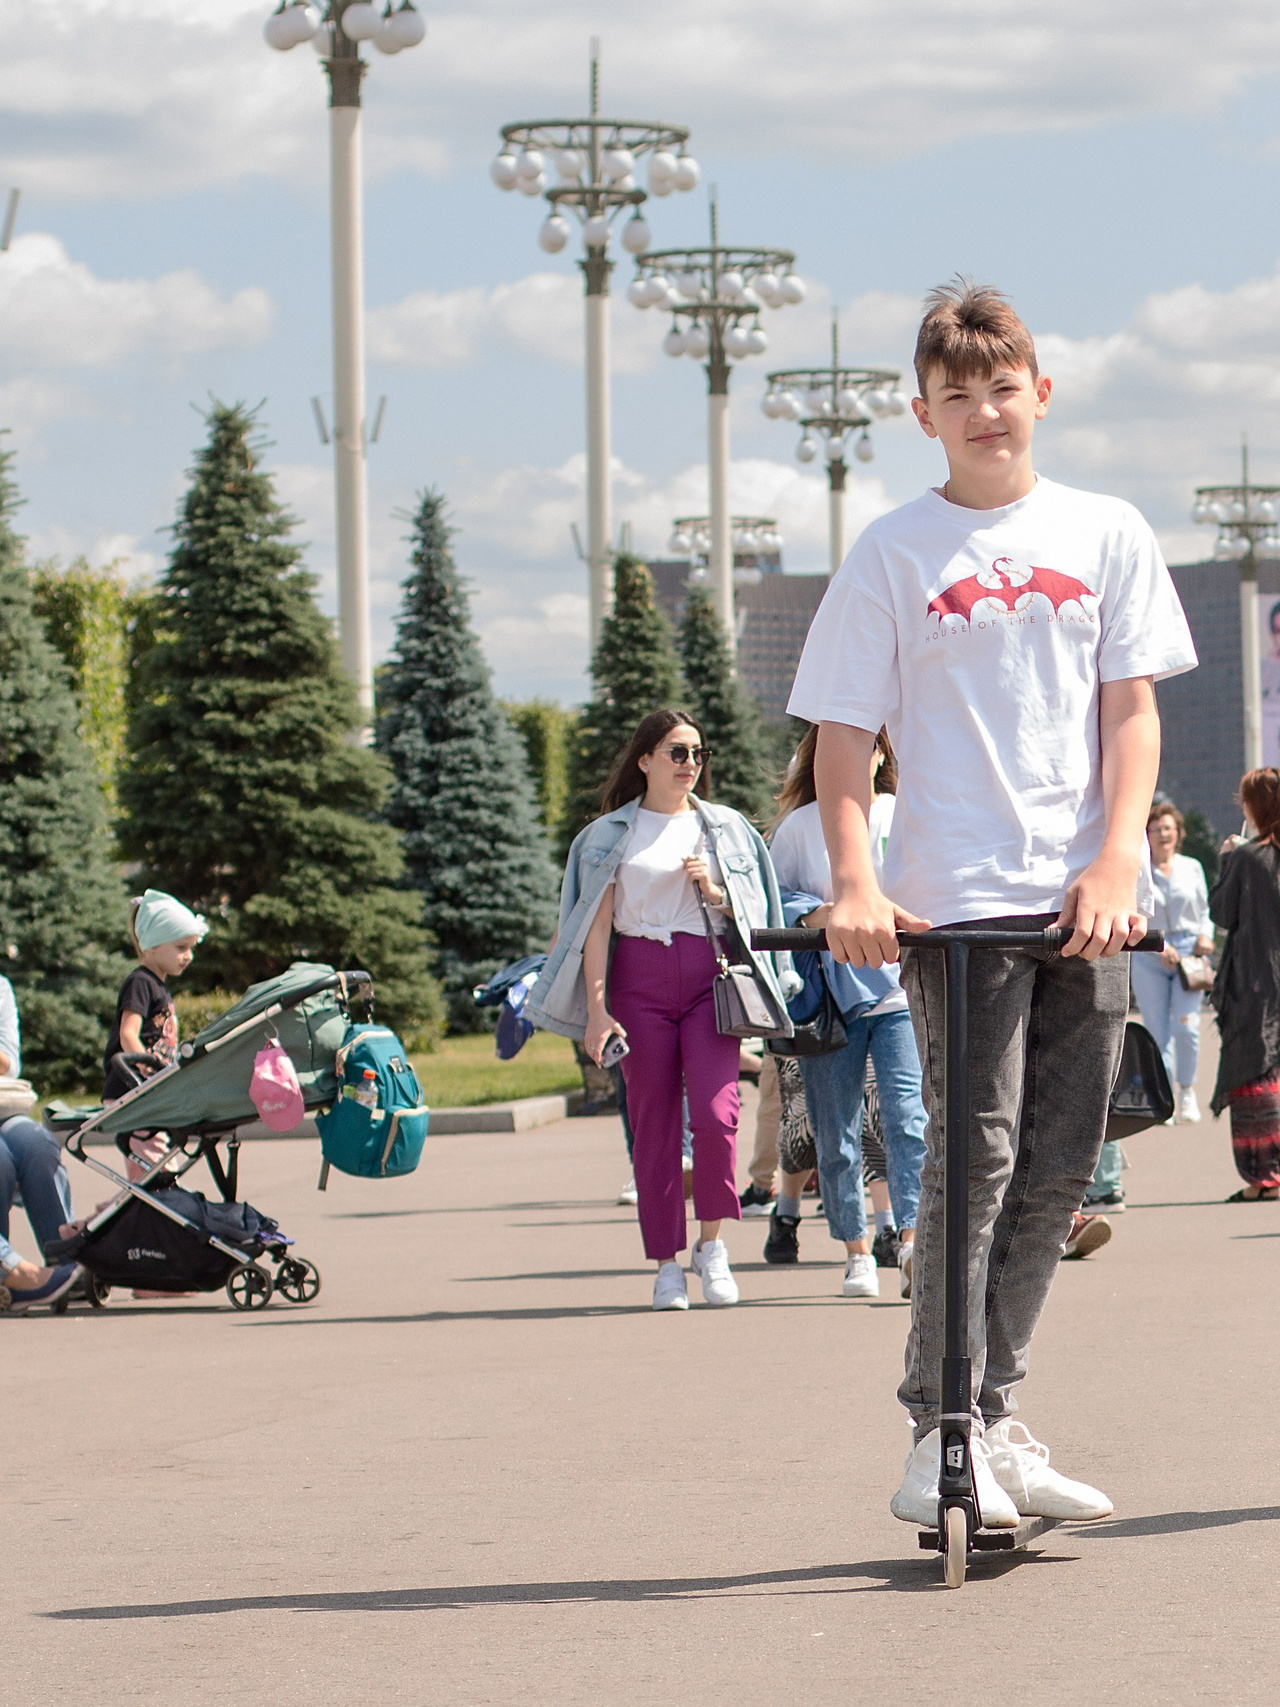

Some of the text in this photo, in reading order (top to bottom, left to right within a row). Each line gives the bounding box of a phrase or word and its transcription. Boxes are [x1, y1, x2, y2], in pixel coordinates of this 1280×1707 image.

[925, 624, 967, 643] HOUSE
[977, 619, 997, 630] OF
[1008, 615, 1036, 626] THE
